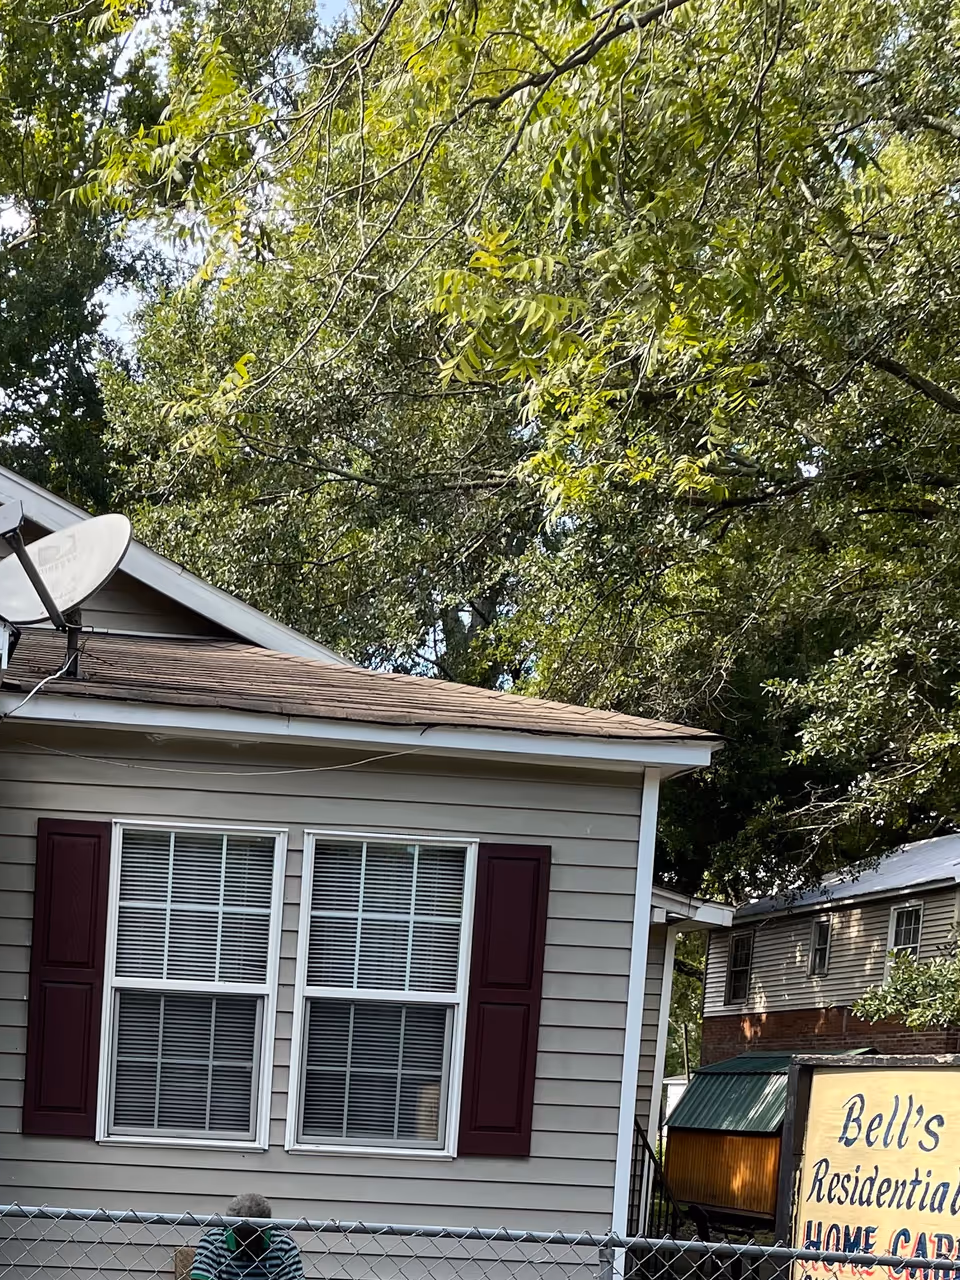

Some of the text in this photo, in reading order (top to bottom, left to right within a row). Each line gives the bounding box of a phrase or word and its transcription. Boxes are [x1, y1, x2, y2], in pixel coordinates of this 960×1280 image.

[838, 1093, 945, 1152] Bell's
[806, 1158, 960, 1216] Residential
[802, 1220, 879, 1275] HOME
